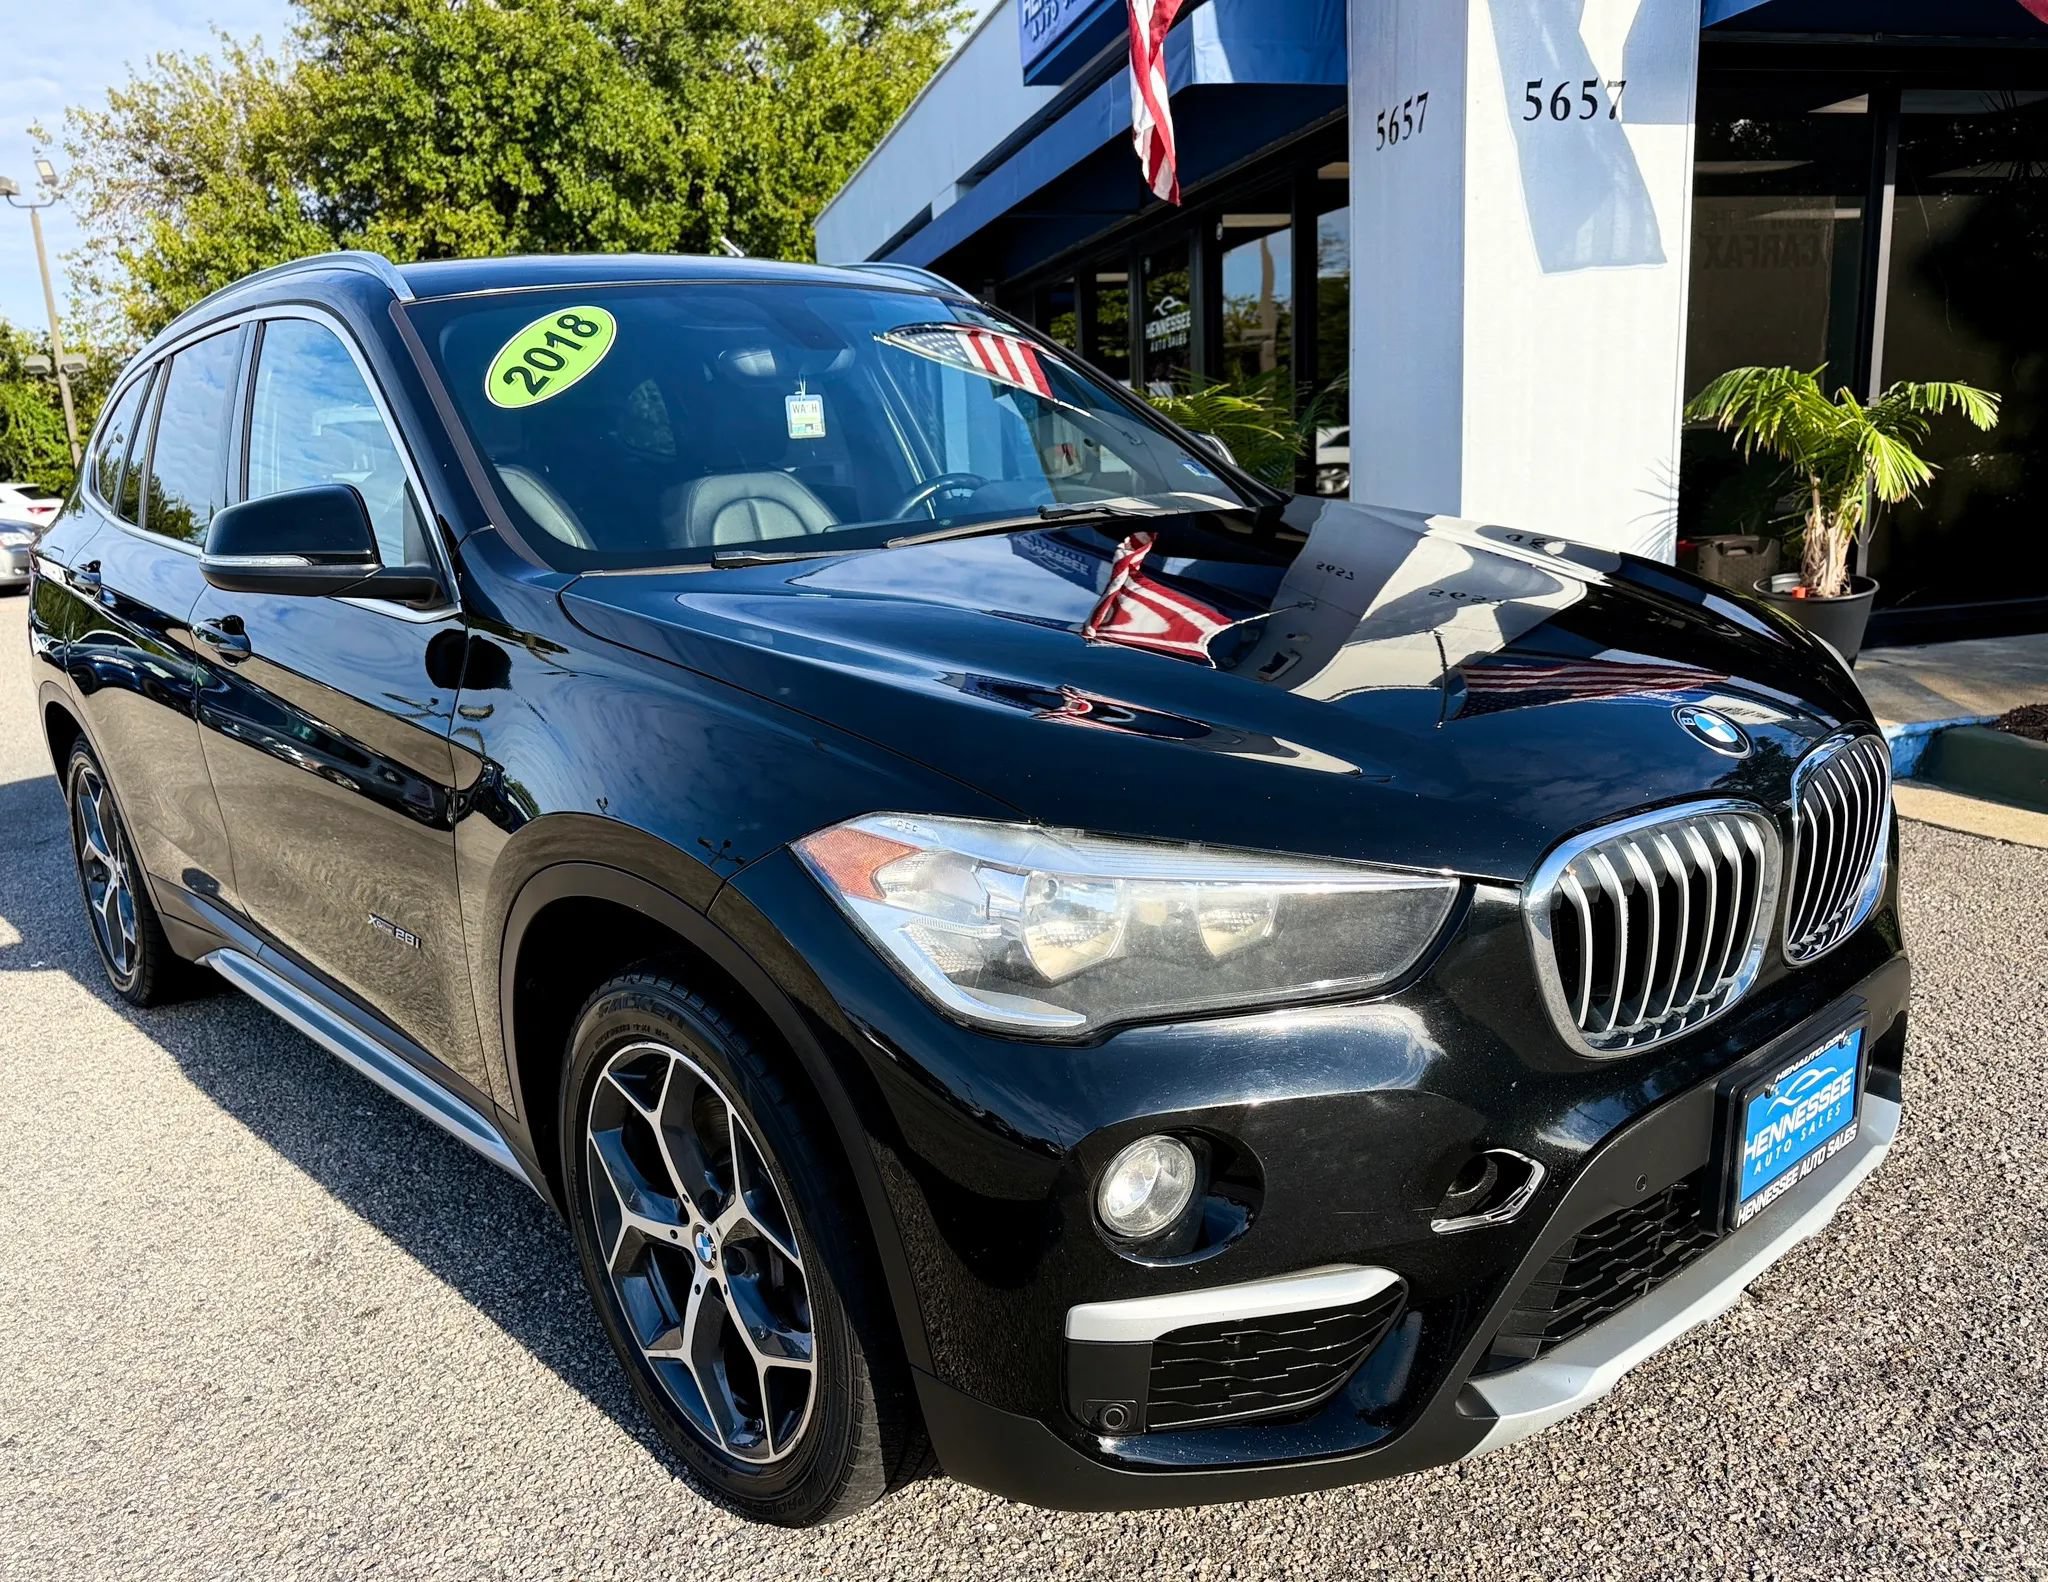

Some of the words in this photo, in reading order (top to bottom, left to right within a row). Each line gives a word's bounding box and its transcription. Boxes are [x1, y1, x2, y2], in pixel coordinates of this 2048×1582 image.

[1376, 91, 1429, 151] 5657
[1522, 77, 1626, 121] 5657
[503, 314, 599, 396] 2018
[792, 402, 818, 414] WAH
[1743, 1066, 1854, 1166] HENNESSEE
[1753, 1140, 1792, 1176] AUTO
[1800, 1102, 1841, 1142] SALES
[1736, 1165, 1800, 1229] HENNESSEE
[1799, 1146, 1827, 1181] AUTO
[1826, 1122, 1858, 1159] SALES
